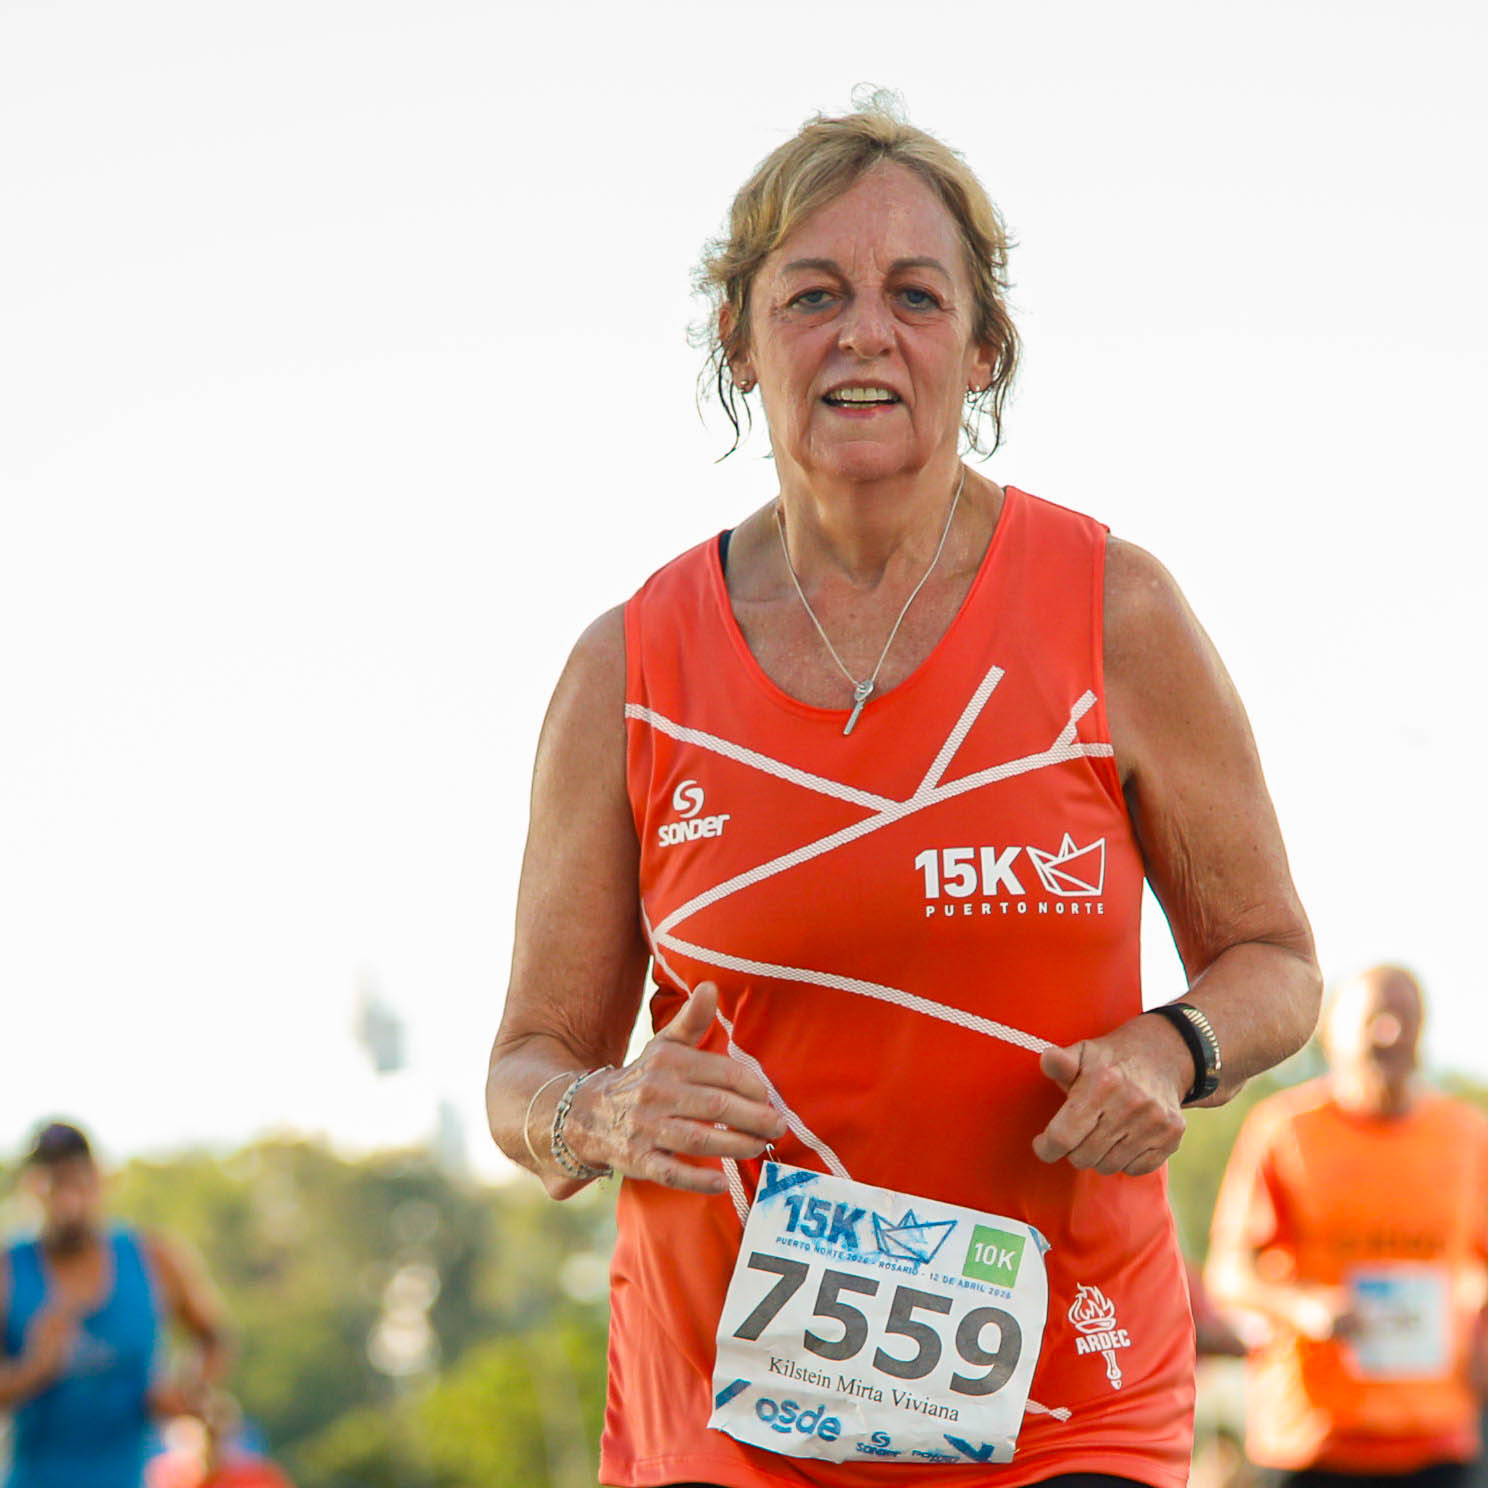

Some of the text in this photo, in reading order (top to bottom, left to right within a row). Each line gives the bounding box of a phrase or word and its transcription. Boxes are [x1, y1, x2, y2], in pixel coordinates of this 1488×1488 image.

[914, 846, 1027, 899] 15K
[783, 1194, 866, 1249] 15K
[776, 1236, 811, 1251] PUERTO
[878, 1261, 919, 1276] ROSARIO
[929, 1272, 939, 1281] 12
[943, 1275, 954, 1285] DE
[958, 1279, 985, 1293] ABRIL
[974, 1241, 1016, 1271] 10K
[732, 1251, 1023, 1396] 7559
[1075, 1329, 1131, 1355] ARDEC
[768, 1356, 959, 1422] Kilstein Mirta Viviana
[755, 1398, 842, 1442] osde
